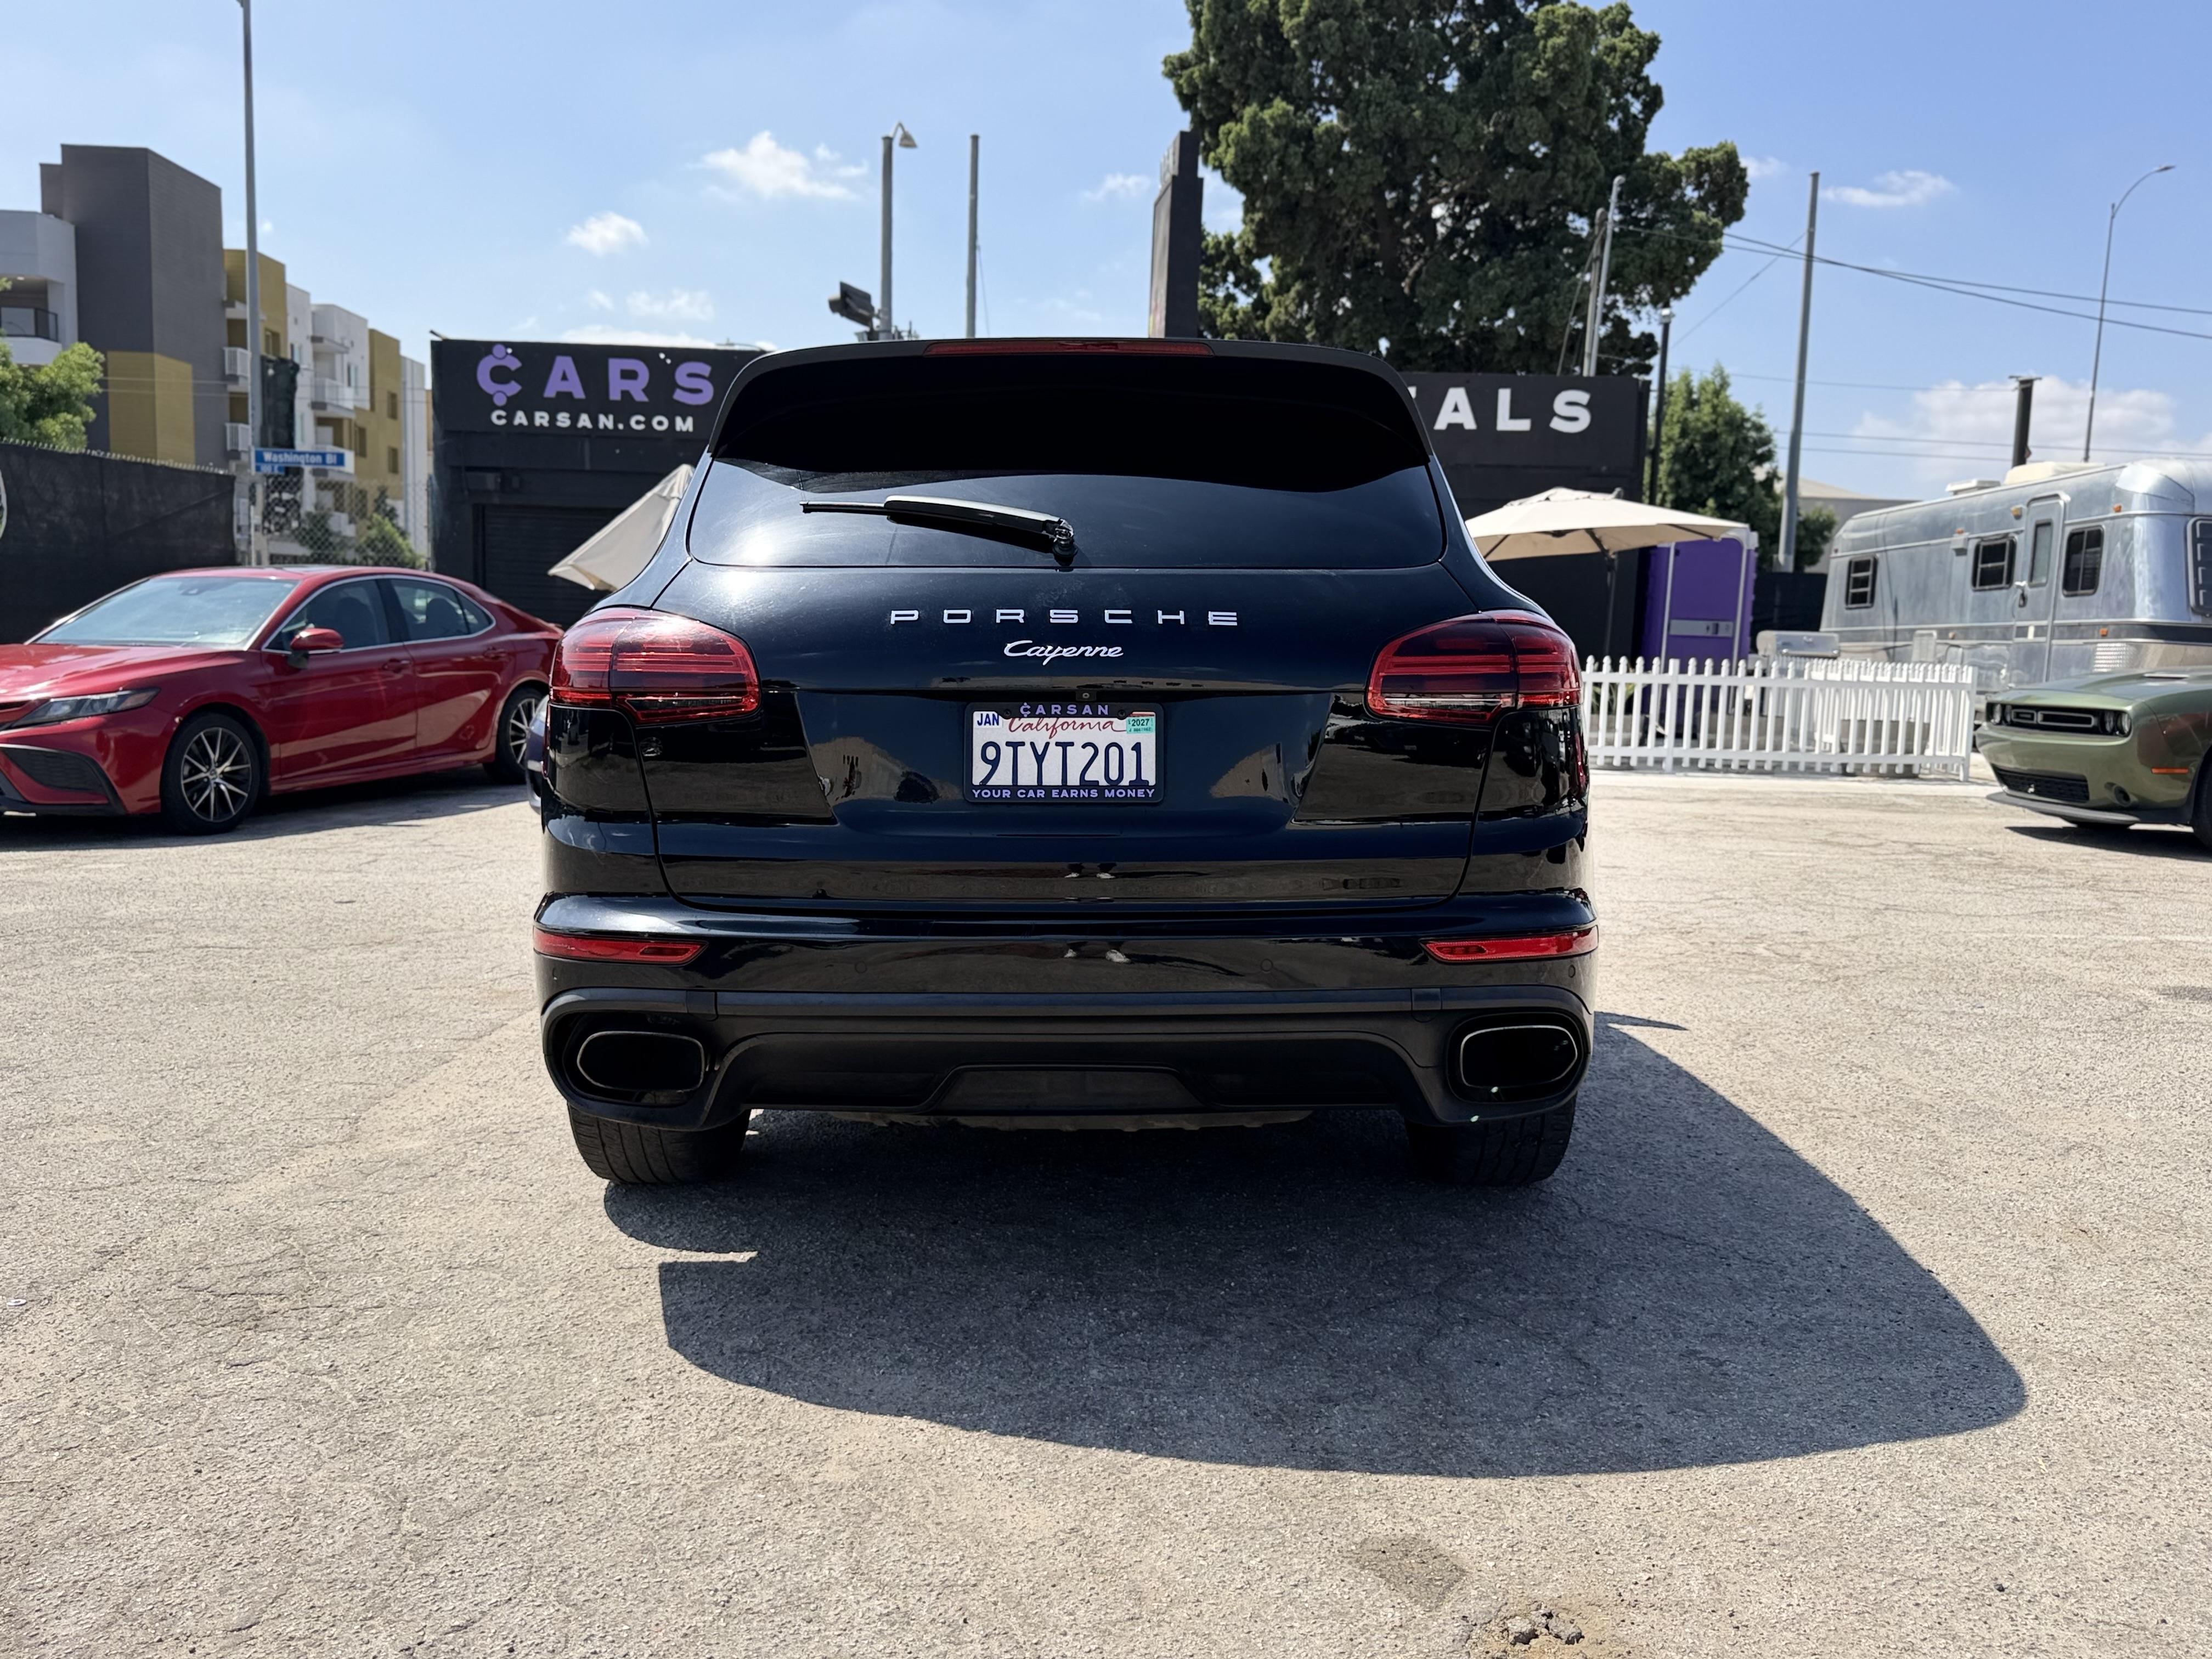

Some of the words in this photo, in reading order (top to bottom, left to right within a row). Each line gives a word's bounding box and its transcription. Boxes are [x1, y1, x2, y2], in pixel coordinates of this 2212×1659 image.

[1408, 386, 1592, 433] ALS
[490, 409, 694, 432] CARSAN.COM
[263, 452, 322, 465] Washington
[890, 608, 1238, 626] PORSCHE
[1003, 639, 1124, 666] Cayenne
[1020, 702, 1109, 718] CARSAN
[977, 713, 1000, 726] JAN
[1008, 717, 1126, 740] California
[1131, 718, 1150, 727] 2027
[979, 741, 1149, 786] 9TYT201
[972, 789, 1011, 798] YOUR
[1017, 789, 1045, 798] CAR
[1052, 789, 1098, 798] EARNS
[1104, 788, 1155, 798] MONEY
